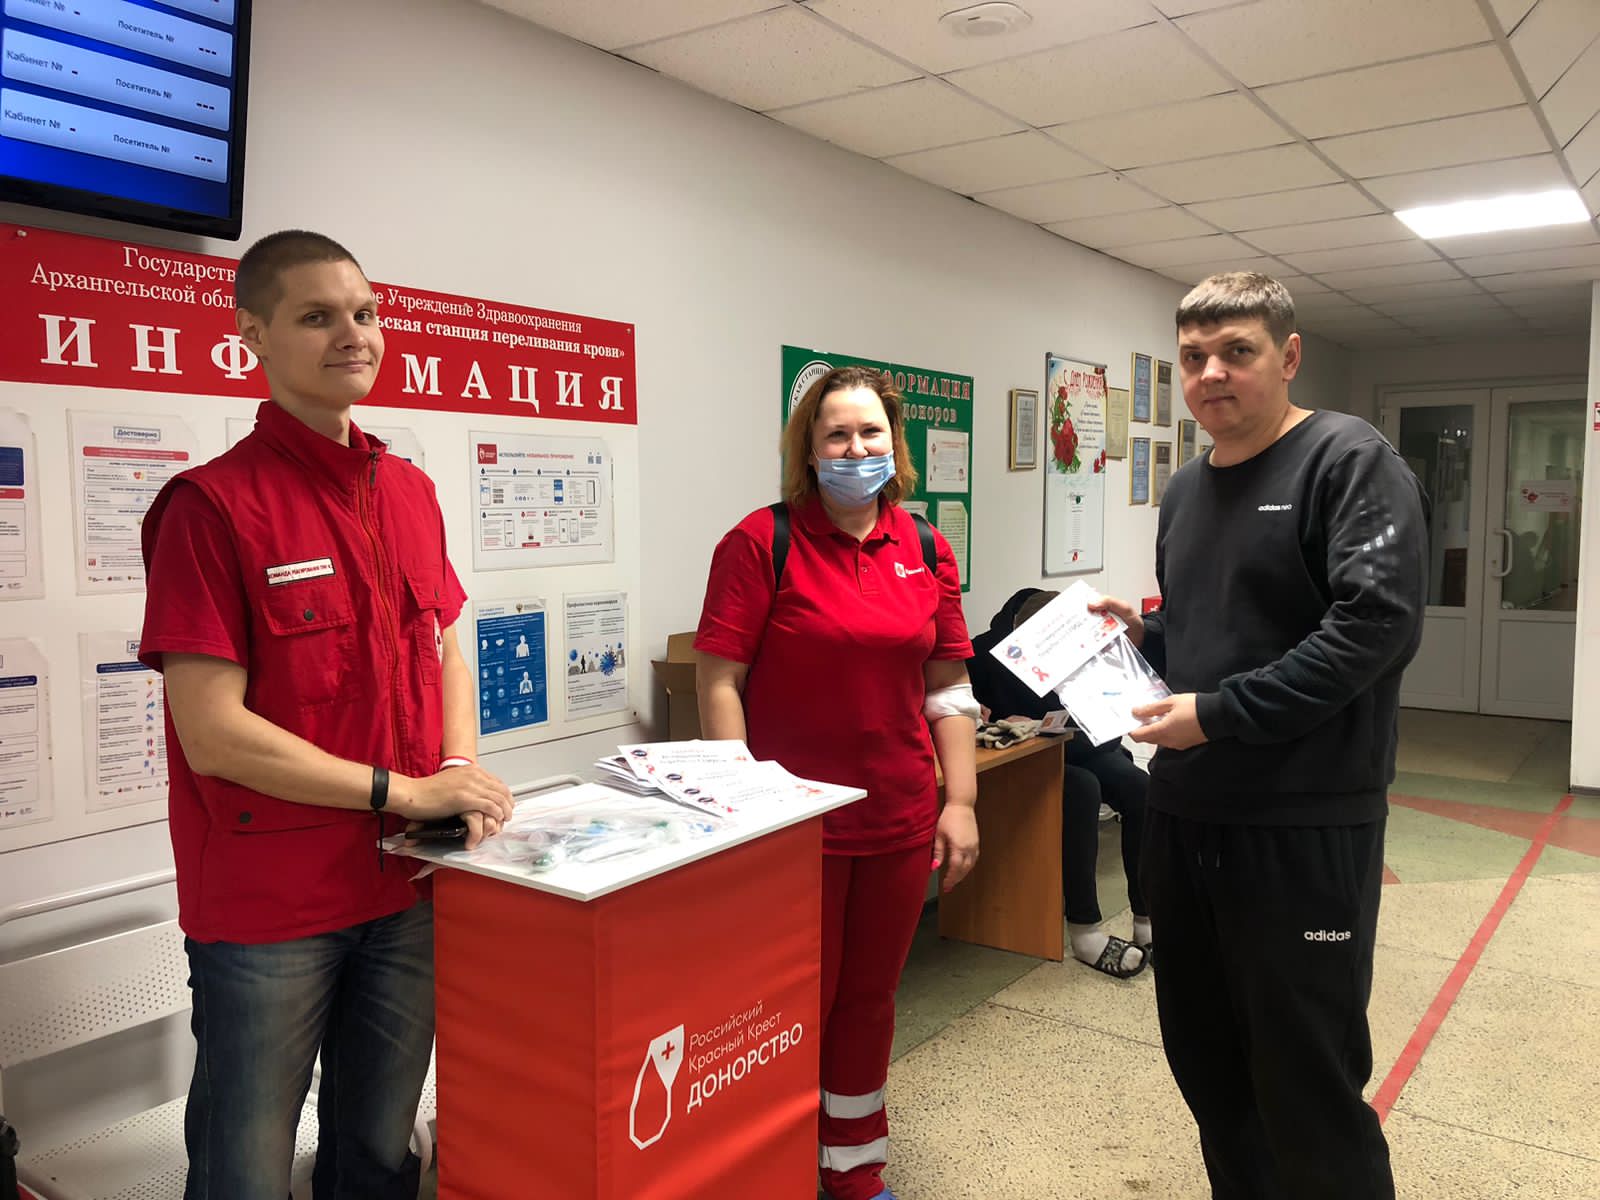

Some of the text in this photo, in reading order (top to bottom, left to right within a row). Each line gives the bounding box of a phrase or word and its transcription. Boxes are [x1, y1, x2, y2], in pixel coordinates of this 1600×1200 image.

[118, 20, 163, 40] Посетитель
[6, 50, 49, 69] Кабинет
[115, 78, 161, 98] Посетитель
[4, 109, 47, 127] Кабинет
[113, 134, 159, 153] Посетитель
[123, 247, 236, 283] Государств
[387, 289, 473, 319] Учреждение
[477, 303, 582, 334] Здравоохранения
[31, 262, 625, 359] Архангельской обл ьская станция переливания крови»
[880, 369, 970, 401] ФОРМАЦИЯ
[117, 429, 158, 438] Достоверно
[1304, 929, 1351, 941] adidas
[689, 1000, 763, 1052] Российский
[688, 1012, 782, 1074] Красный Крест
[687, 1023, 803, 1114] ДОНОРСТВО
